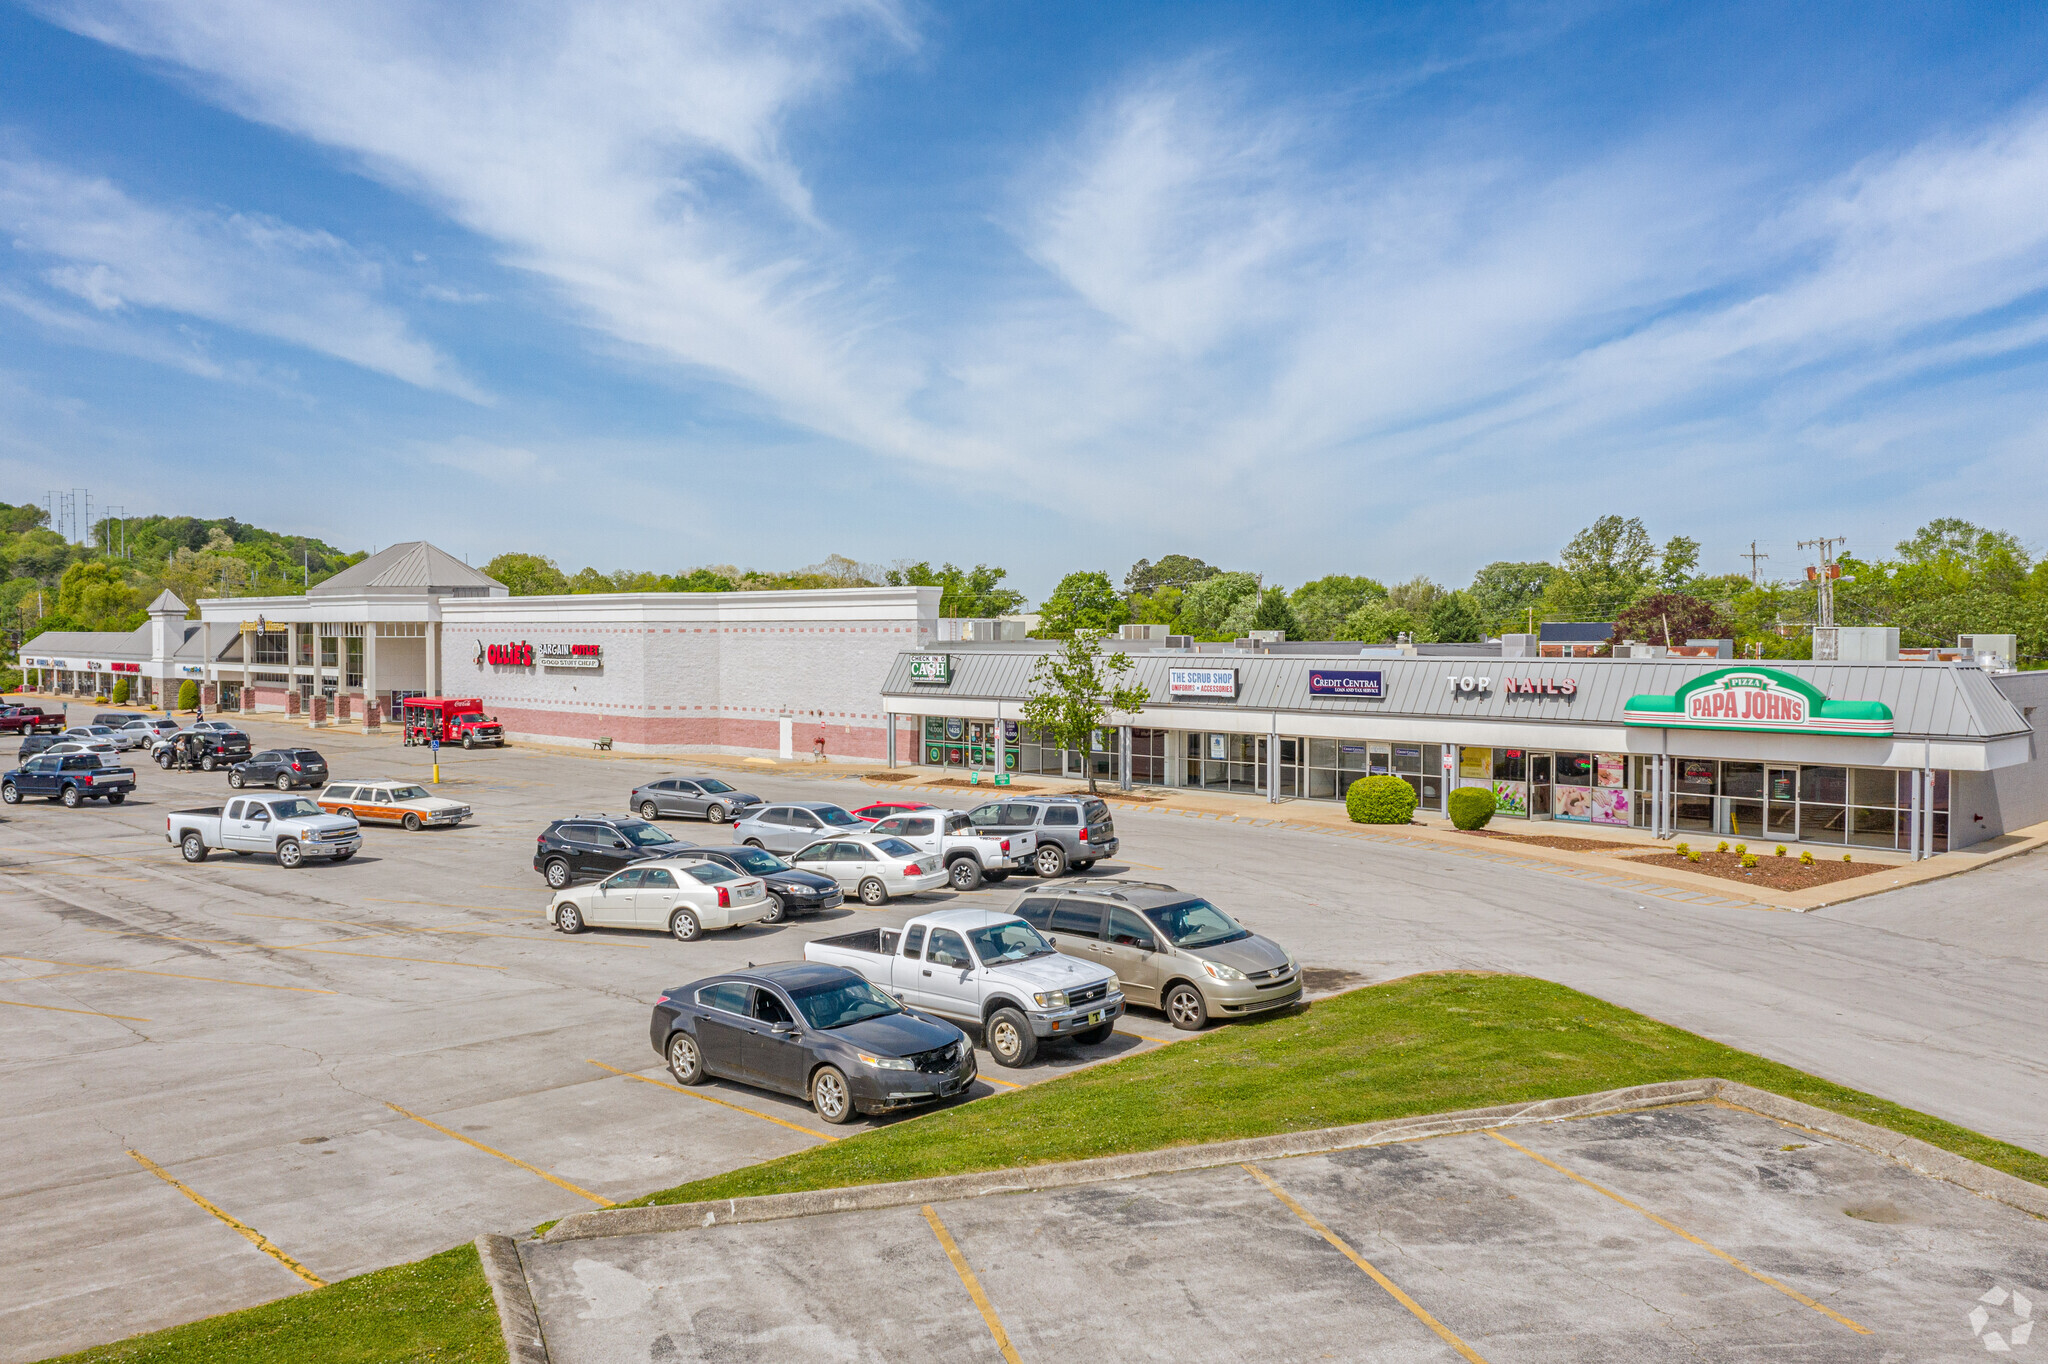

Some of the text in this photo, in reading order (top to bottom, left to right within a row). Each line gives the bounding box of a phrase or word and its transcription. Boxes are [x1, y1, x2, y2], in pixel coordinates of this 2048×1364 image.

[539, 644, 599, 656] BARGAIN OUTLET
[1172, 672, 1232, 684] THE SCRUB SHOP
[1313, 677, 1379, 688] CREDIT CENTRAL
[1731, 678, 1760, 687] PIZZA
[1171, 684, 1233, 693] UNIFORMS ACCESSORIES
[1447, 676, 1576, 694] TOP NAILS
[1692, 691, 1802, 721] PAPA JOHN'S
[1092, 1011, 1101, 1022] T
